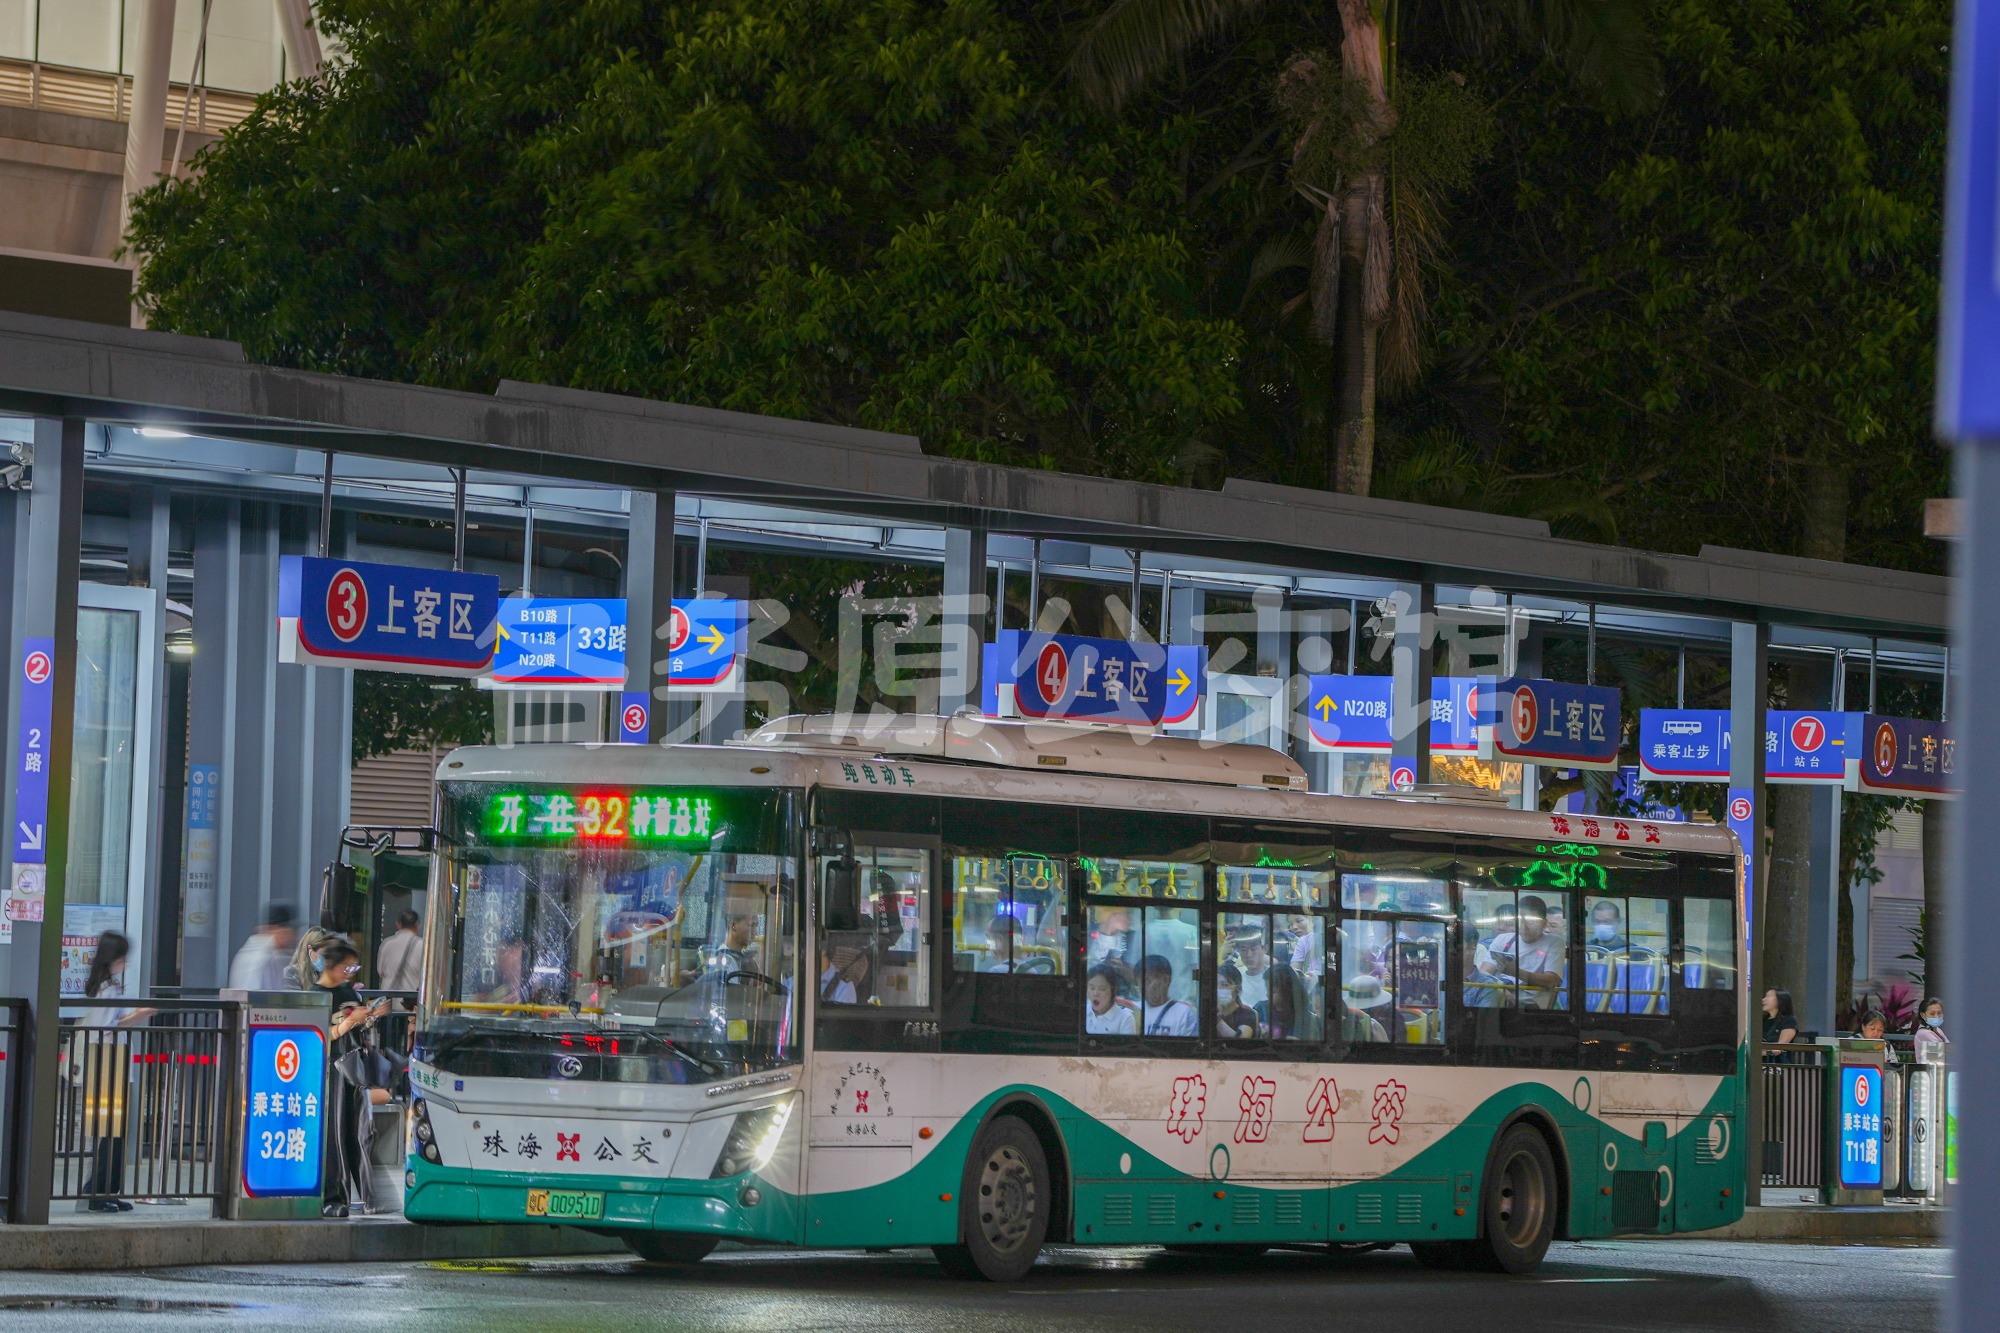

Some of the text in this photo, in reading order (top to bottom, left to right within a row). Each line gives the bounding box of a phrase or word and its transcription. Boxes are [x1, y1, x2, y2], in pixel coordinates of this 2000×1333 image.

[377, 585, 475, 640] 上客区
[520, 609, 557, 624] B10路
[520, 631, 556, 646] T11路
[578, 624, 627, 653] 33路
[519, 653, 556, 668] N20路
[1075, 655, 1149, 703] 上客区
[1344, 699, 1388, 719] N20路
[1543, 698, 1606, 742] 上客区
[1653, 743, 1710, 759] 乘客止步
[1794, 756, 1820, 768] 站台
[841, 762, 915, 787] 纯电动车
[583, 796, 623, 836] 32
[1550, 816, 1660, 843] 珠海公交
[253, 1091, 318, 1117] 乘车站台
[1167, 1074, 1406, 1144] 珠海公交
[1843, 1112, 1880, 1132] 乘车站台
[260, 1127, 307, 1162] 32路
[1845, 1138, 1878, 1165] T11路
